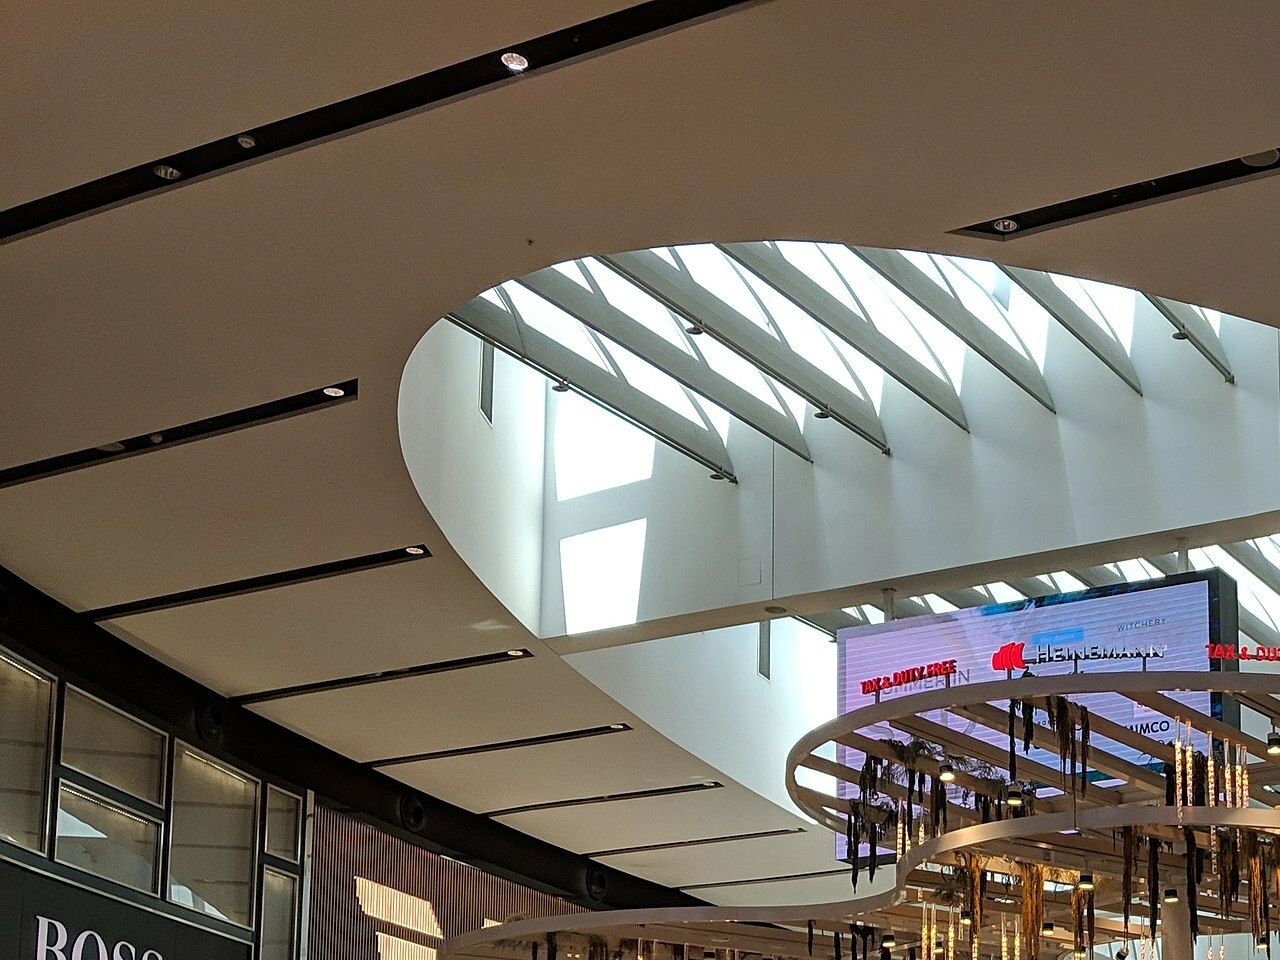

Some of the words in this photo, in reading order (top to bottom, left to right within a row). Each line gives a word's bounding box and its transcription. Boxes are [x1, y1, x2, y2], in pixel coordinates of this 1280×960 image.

[1118, 617, 1167, 632] WITCHERY
[1036, 643, 1164, 663] HEINEMANN
[1206, 643, 1235, 660] TAX
[1240, 646, 1251, 661] &
[860, 677, 881, 695] TAX
[881, 676, 892, 688] &
[892, 666, 925, 686] DUTY
[926, 659, 957, 678] FREE
